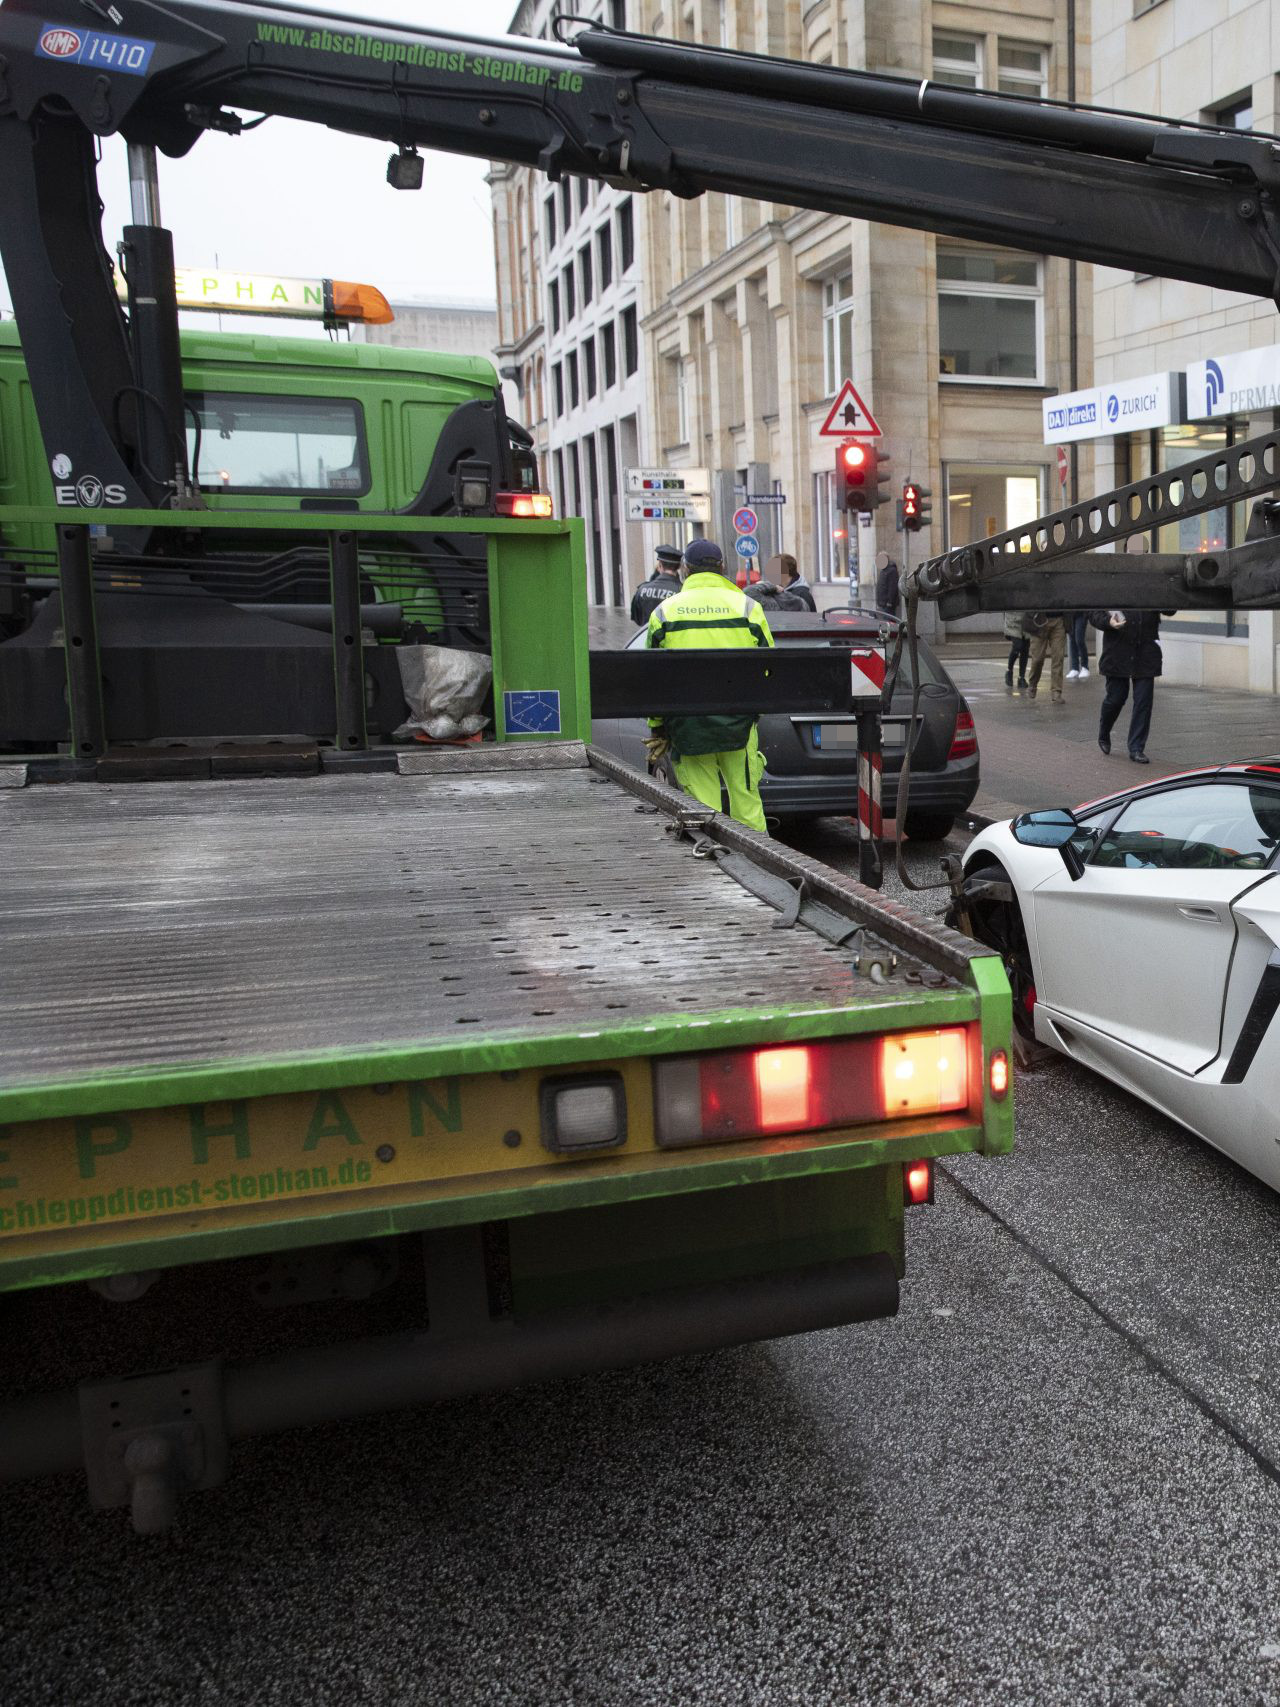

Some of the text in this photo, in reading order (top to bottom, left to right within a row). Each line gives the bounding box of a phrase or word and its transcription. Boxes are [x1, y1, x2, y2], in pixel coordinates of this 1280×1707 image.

[45, 32, 145, 68] HMF 1410
[257, 22, 583, 93] www.abschleppdienst-stephan.de
[1069, 405, 1096, 425] direkt
[1122, 396, 1156, 415] ZURICH
[677, 604, 730, 615] Stephan
